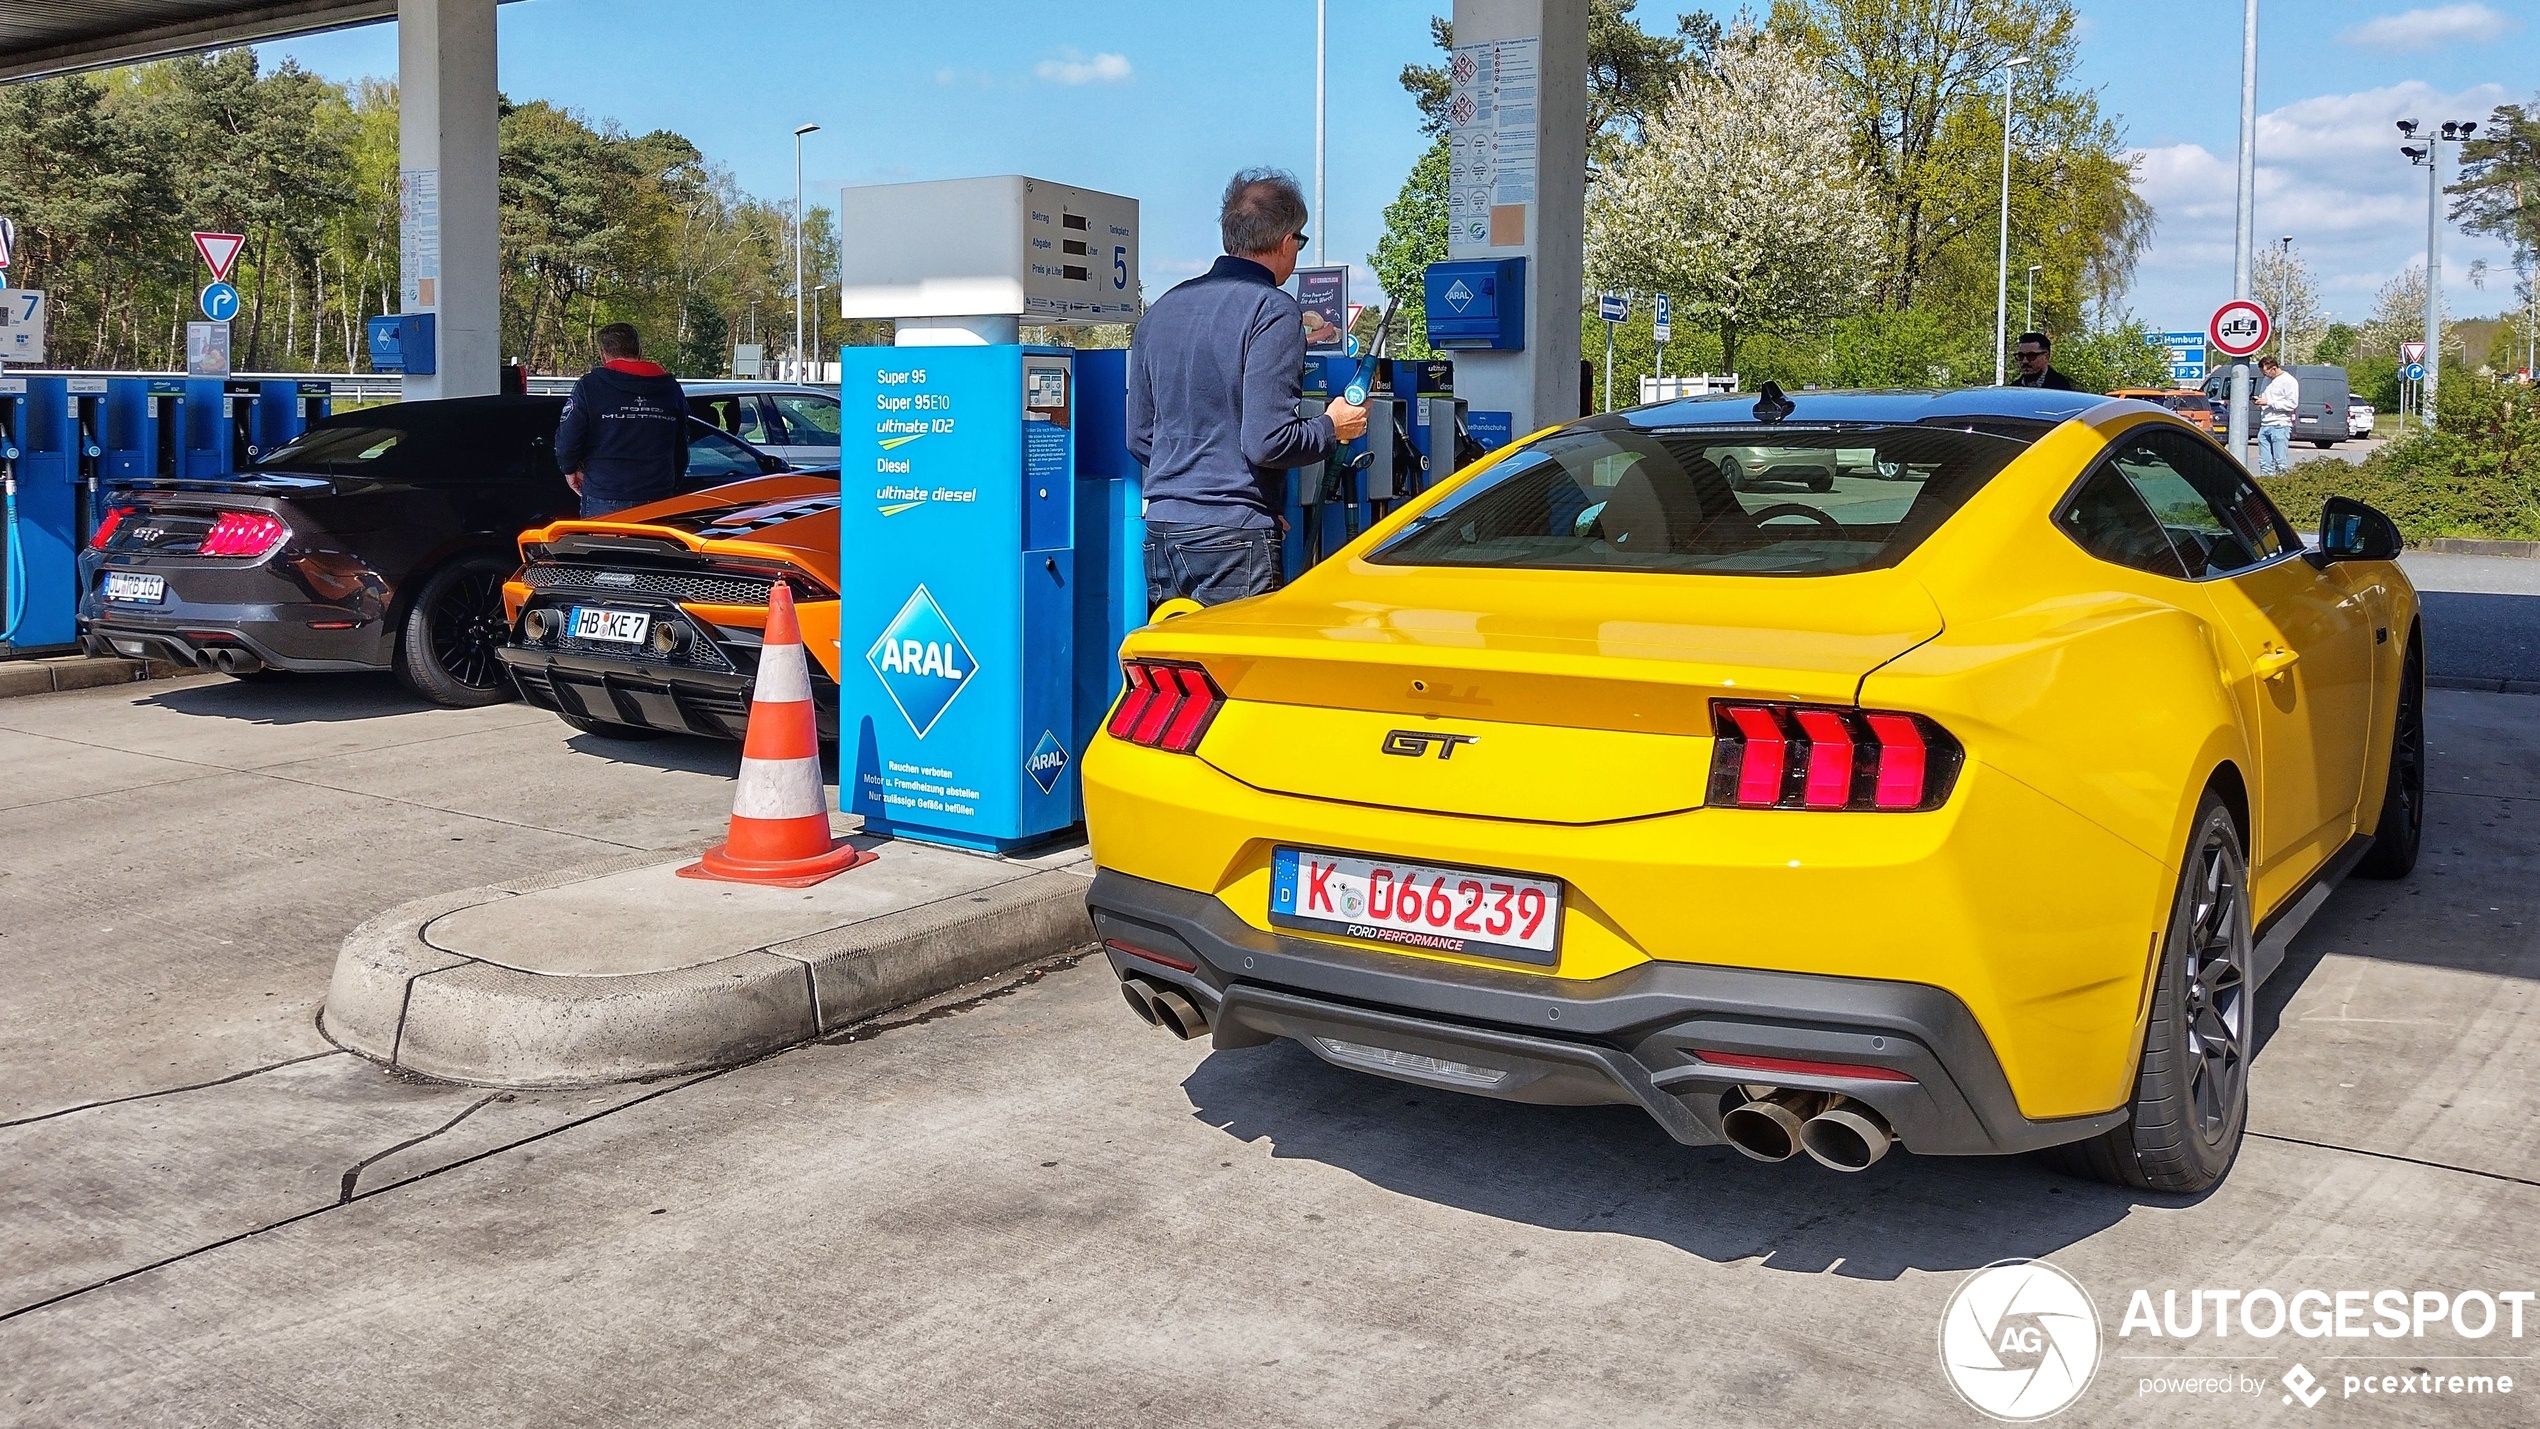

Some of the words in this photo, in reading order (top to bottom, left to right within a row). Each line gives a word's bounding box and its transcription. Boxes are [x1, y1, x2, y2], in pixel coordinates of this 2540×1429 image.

[1032, 211, 1050, 224] Betrag
[1109, 225, 1130, 236] Tankplatz
[1032, 238, 1051, 249] Abgabe
[1088, 246, 1098, 256] Liter
[1032, 264, 1045, 273] Preis
[1046, 266, 1051, 276] je
[1052, 267, 1063, 276] Liter
[1113, 246, 1127, 290] 5
[1449, 291, 1469, 300] ARAL
[22, 295, 39, 320] 7
[1659, 298, 1666, 321] P
[2164, 335, 2202, 344] Hamburg
[877, 369, 909, 386] Super
[912, 369, 926, 383] 95
[1377, 381, 1391, 390] Diesel
[877, 394, 912, 412] Super
[877, 419, 928, 433] ultimate
[931, 419, 954, 433] 102
[877, 458, 910, 473] Diesel
[877, 485, 928, 500] ultimate
[932, 487, 977, 502] diesel
[110, 575, 120, 593] OL
[127, 577, 140, 595] RB
[141, 577, 161, 596] 161
[578, 612, 600, 634] HB
[608, 614, 631, 638] KE
[633, 617, 644, 639] 7
[881, 638, 962, 679] ARAL
[1381, 729, 1481, 760] GT
[889, 760, 919, 774] Rauchen
[921, 766, 953, 779] verboten
[1032, 751, 1063, 771] ARAL
[863, 774, 884, 785] Motor
[885, 779, 892, 787] u.
[894, 779, 944, 796] Fremdheizung
[946, 786, 980, 799] abstellen
[868, 791, 881, 801] Nur
[883, 793, 916, 807] zulässige
[917, 798, 943, 811] Gefäße
[945, 802, 974, 816] befüllen
[1281, 888, 1291, 903] D
[1308, 861, 1337, 913] K
[1368, 868, 1546, 940] 066239
[1346, 924, 1377, 939] FORD
[1376, 928, 1464, 951] PERFORMANCE
